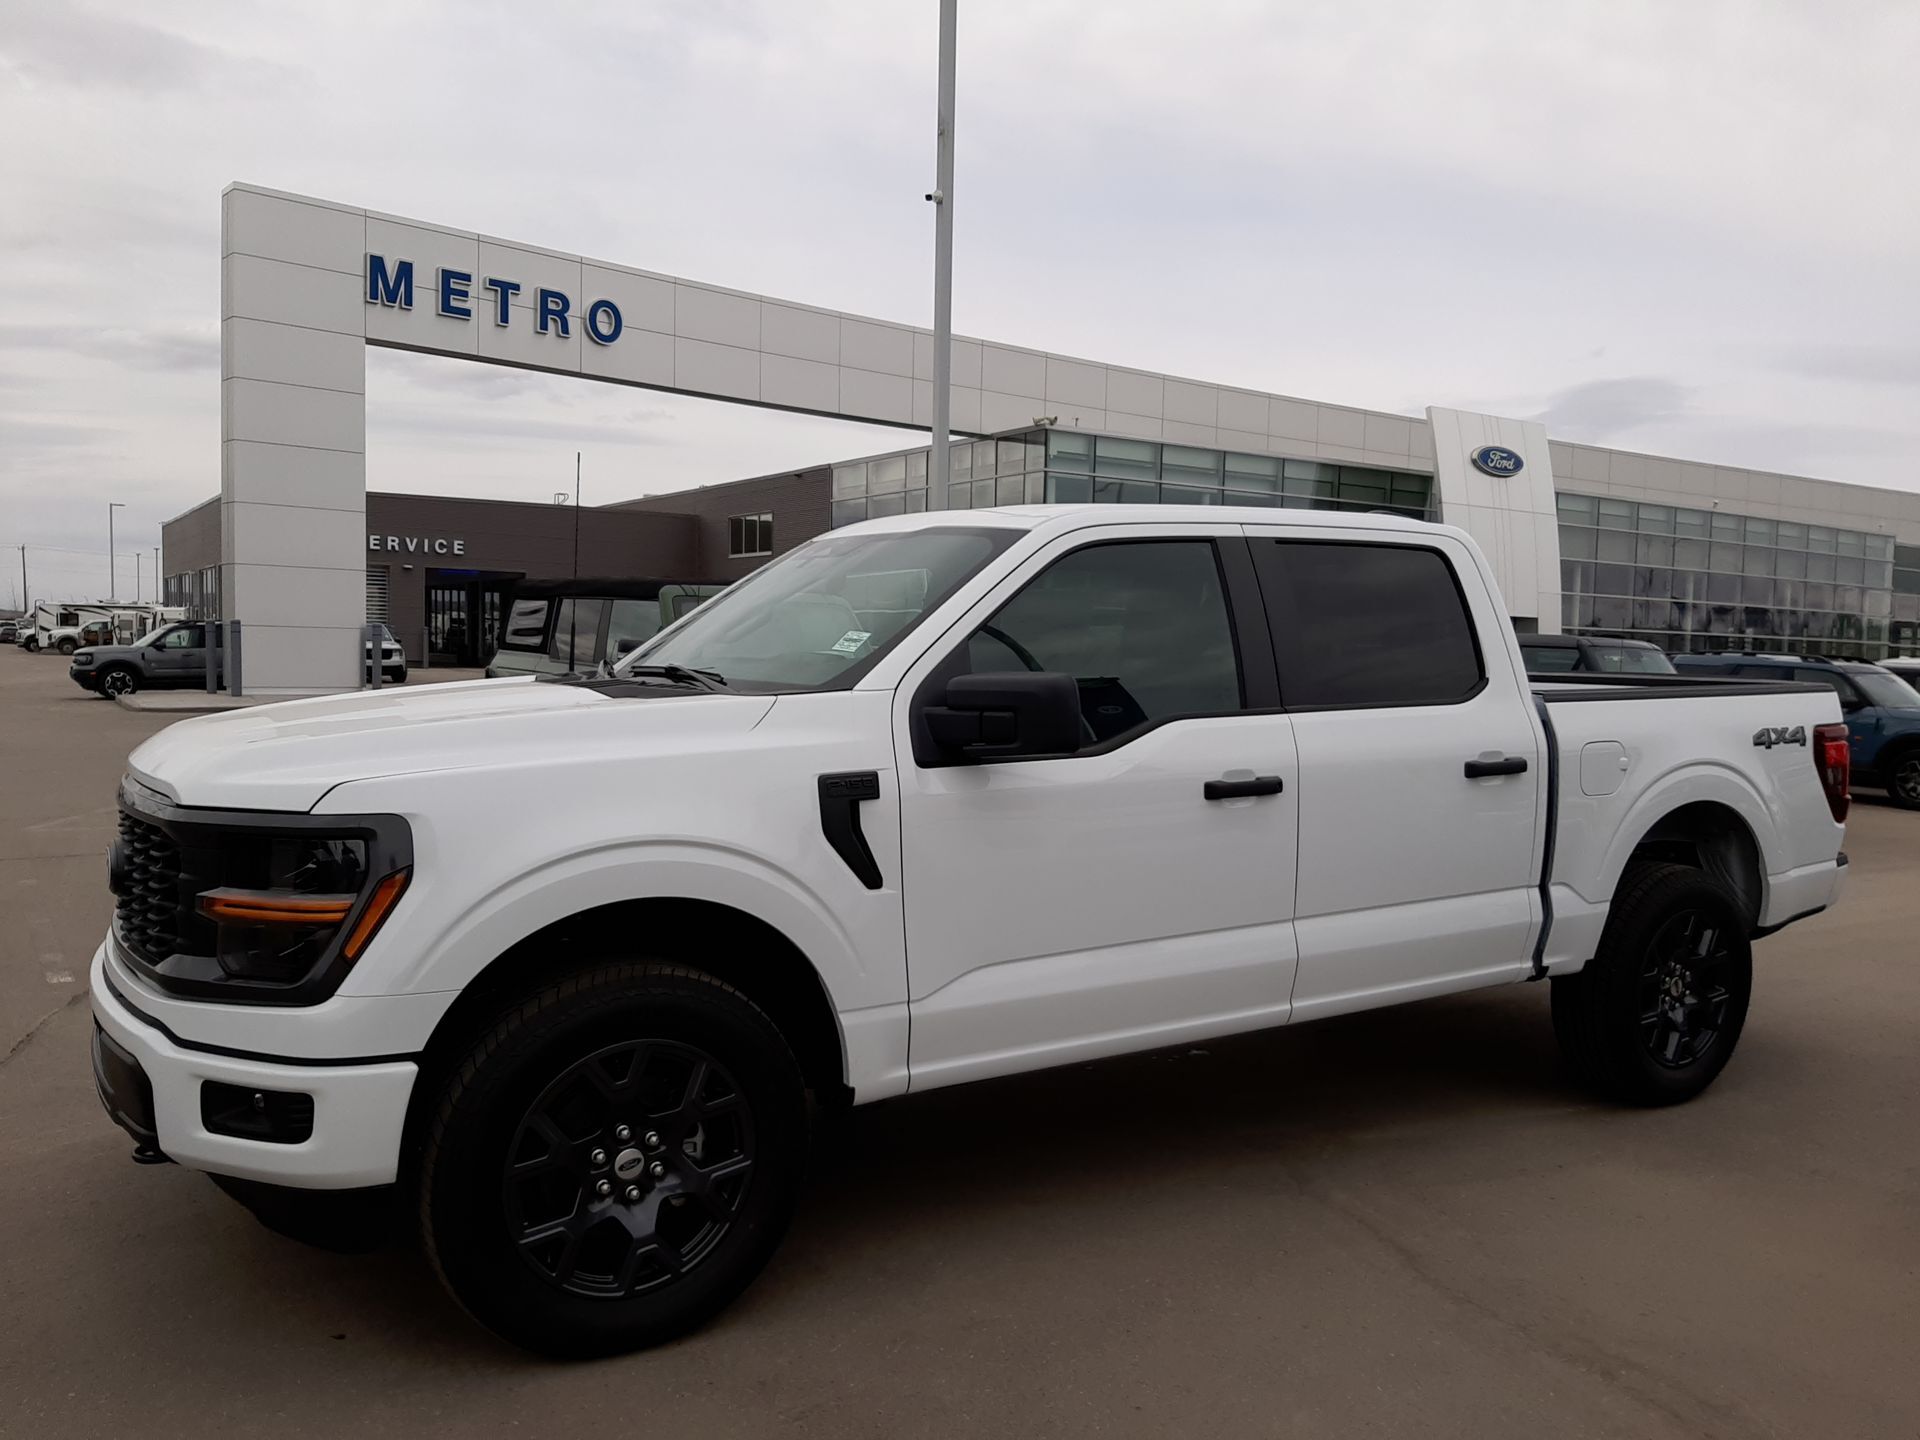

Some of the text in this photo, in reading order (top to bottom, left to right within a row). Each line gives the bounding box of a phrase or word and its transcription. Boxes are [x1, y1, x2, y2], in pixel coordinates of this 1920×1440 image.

[366, 252, 624, 346] METRO
[1487, 450, 1515, 470] Ford
[369, 535, 465, 555] ERVICE
